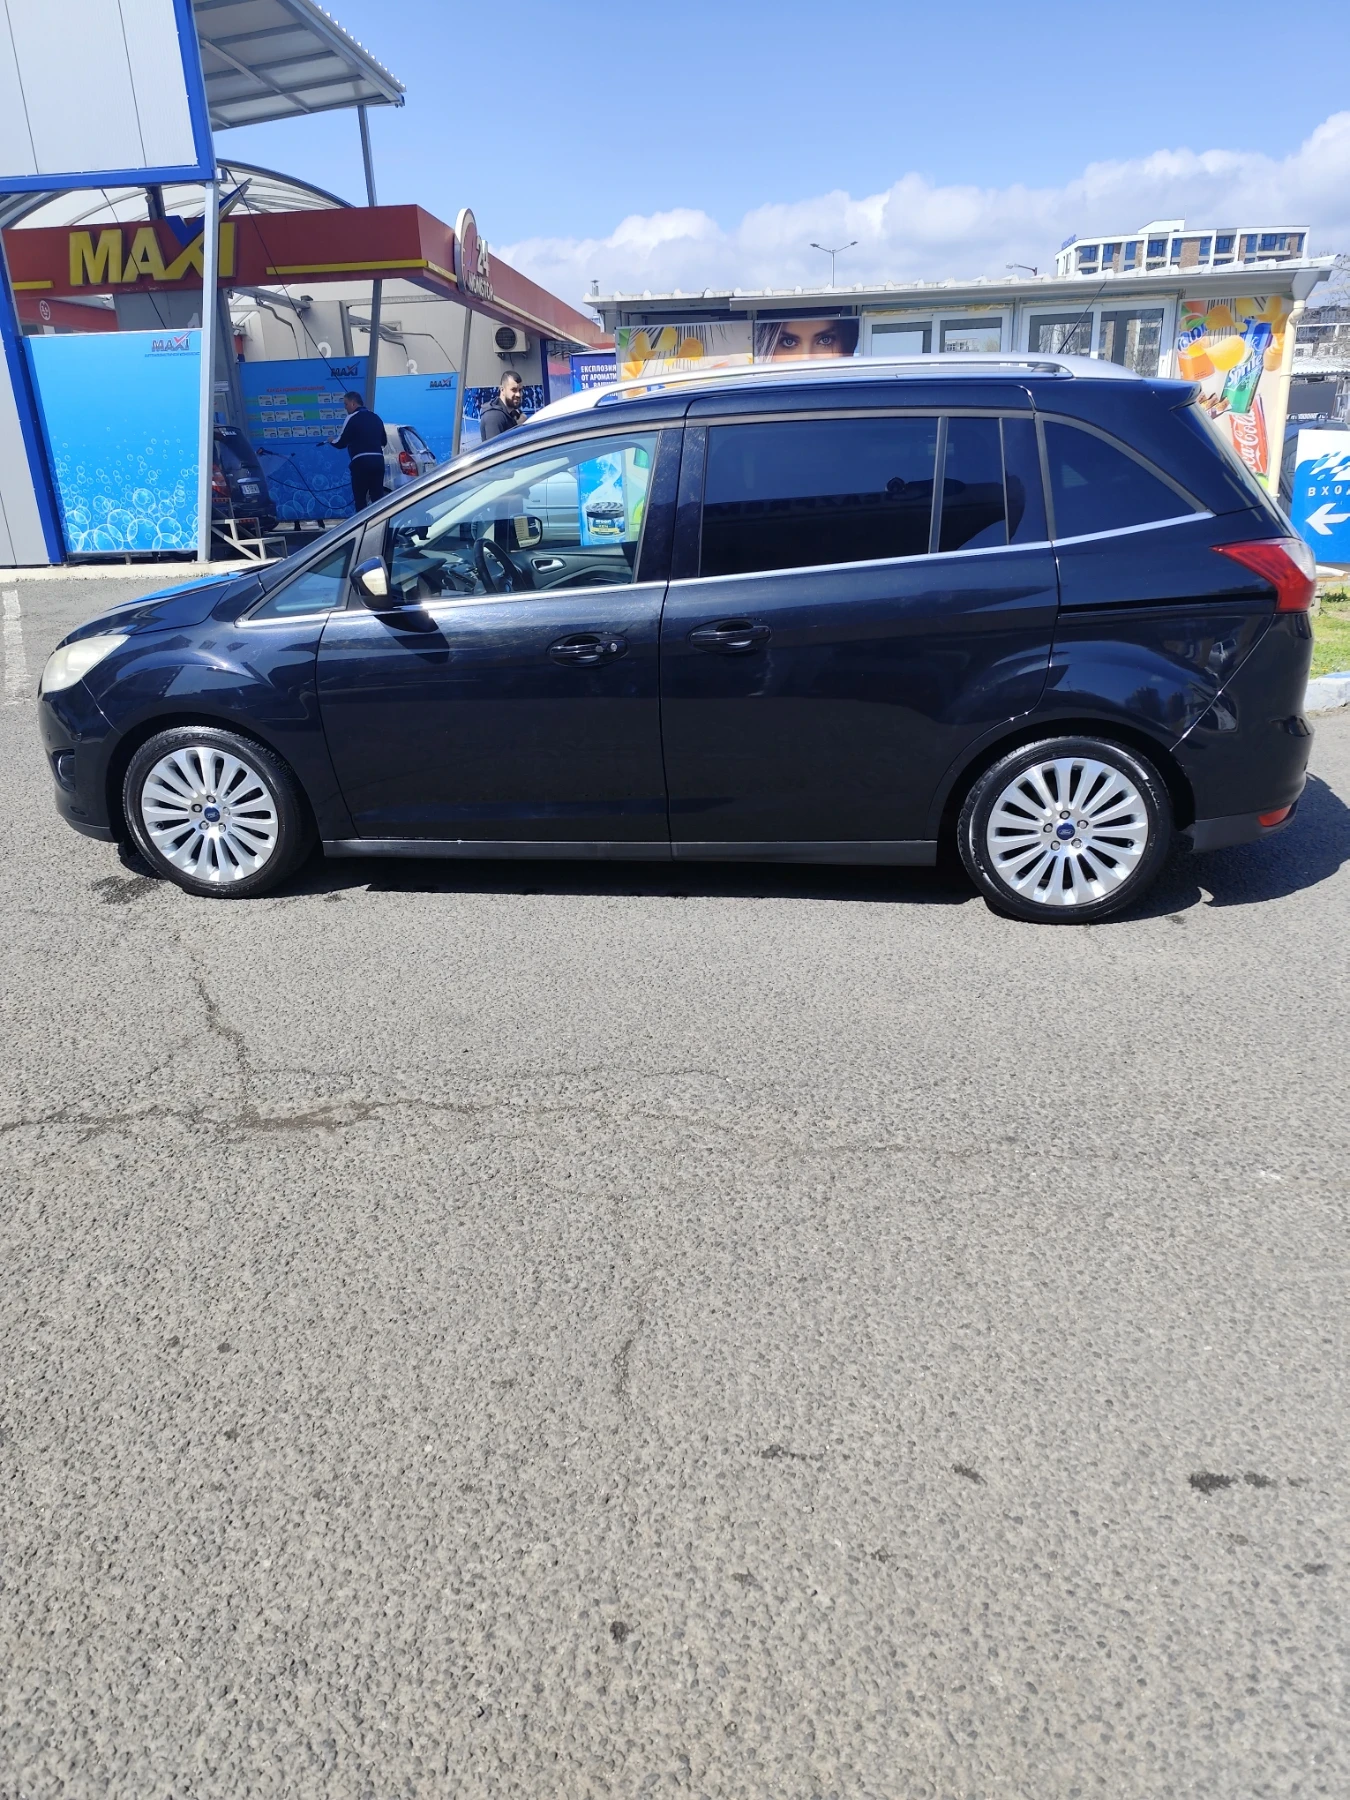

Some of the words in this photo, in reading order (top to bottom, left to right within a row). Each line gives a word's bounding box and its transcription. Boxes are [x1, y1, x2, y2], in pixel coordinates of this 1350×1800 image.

[69, 212, 237, 286] MAXI
[476, 235, 489, 277] 24
[152, 334, 191, 352] MAXI
[331, 364, 359, 377] MAXI
[581, 374, 589, 382] ОТ
[590, 372, 617, 381] АРОМАТИ
[1226, 353, 1264, 386] Sprite
